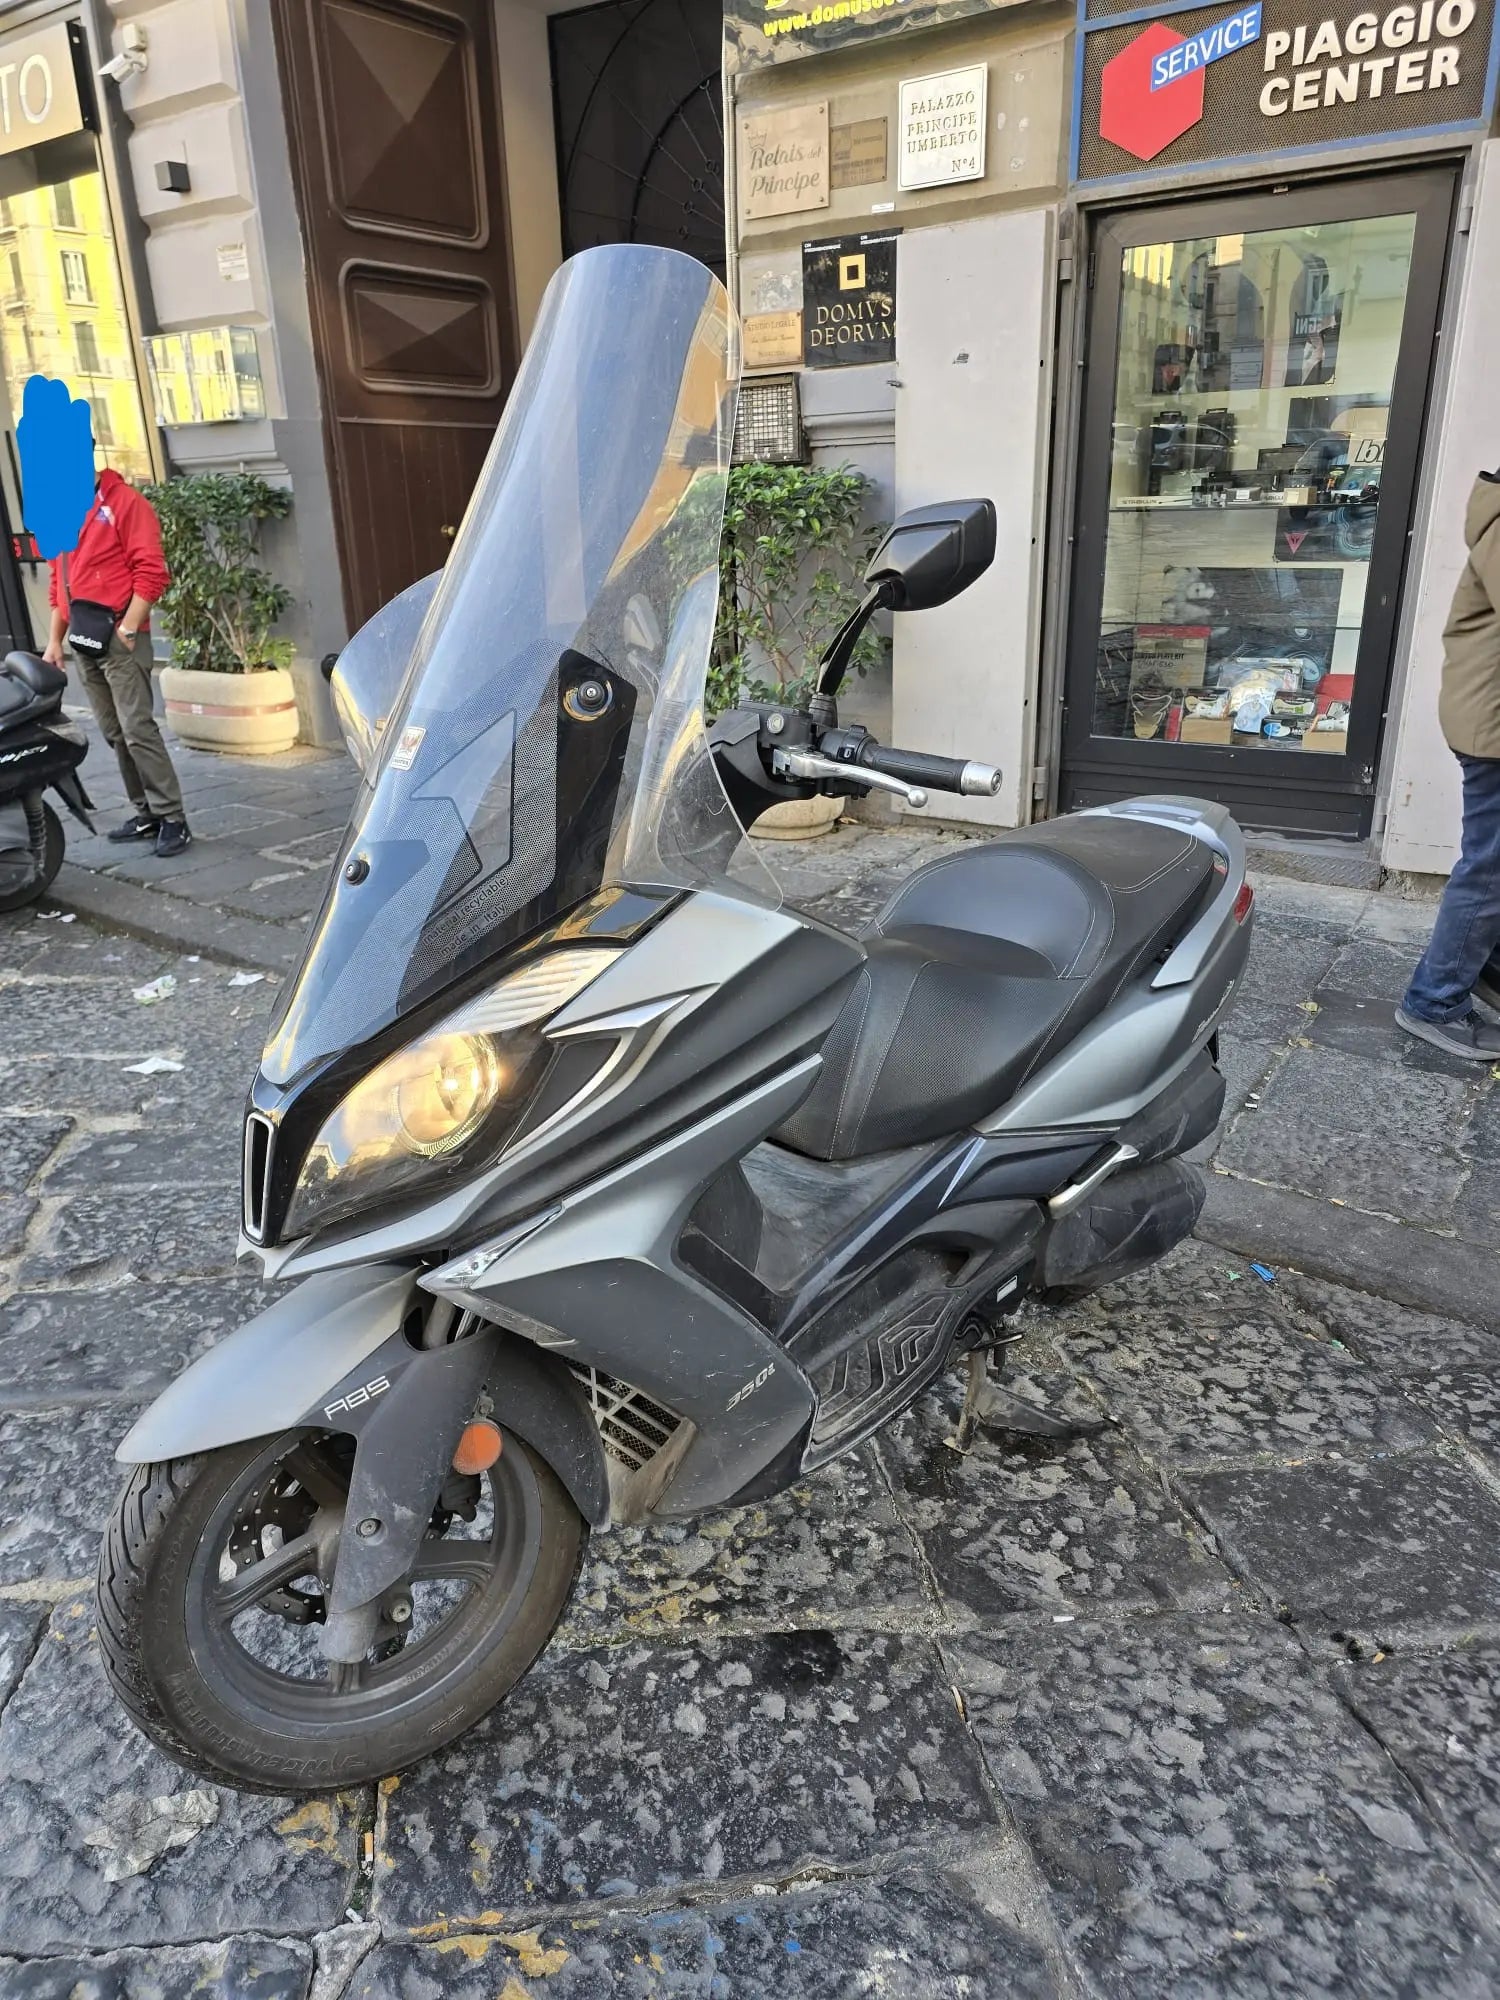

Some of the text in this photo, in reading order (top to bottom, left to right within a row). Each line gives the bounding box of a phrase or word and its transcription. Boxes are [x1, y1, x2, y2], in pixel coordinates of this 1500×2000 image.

[1154, 9, 1258, 86] SERVICE
[1264, 0, 1476, 72] PIAGGIO
[1259, 46, 1461, 117] CENTER
[911, 90, 975, 115] PALAZZO
[907, 111, 977, 136] PRINCIPE
[907, 129, 978, 153] UMBERTO
[750, 144, 804, 170] Relais
[751, 171, 820, 199] Principe
[817, 300, 891, 325] DOMVS
[810, 320, 897, 347] DEORVM
[69, 634, 103, 650] adidas
[422, 877, 507, 946] material recyclable
[440, 903, 507, 957] made in Italy
[323, 1375, 391, 1421] ABS
